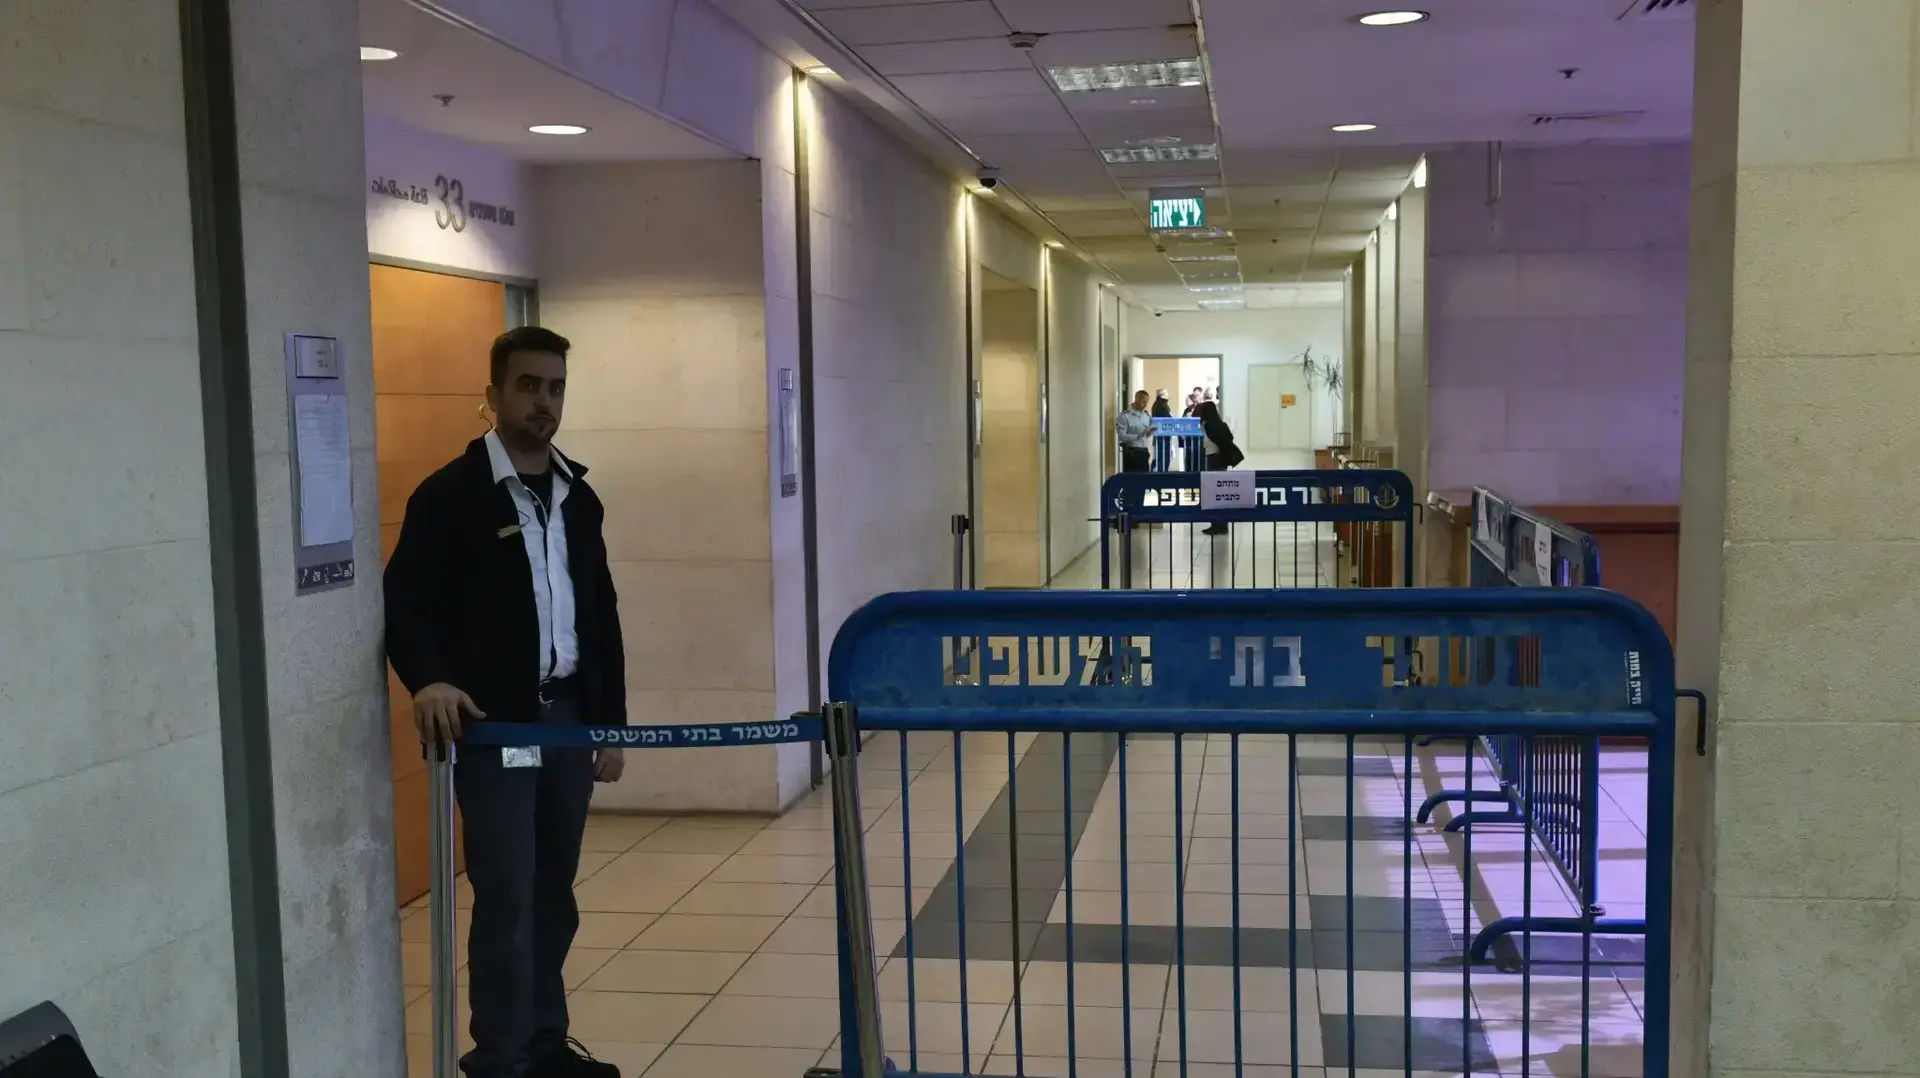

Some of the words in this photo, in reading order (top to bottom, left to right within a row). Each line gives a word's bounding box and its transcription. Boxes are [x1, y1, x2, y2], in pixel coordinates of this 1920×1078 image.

[434, 174, 467, 233] 33
[1152, 199, 1193, 227] יציאה
[1216, 480, 1240, 488] מתחם
[1215, 493, 1241, 501] כתבים
[941, 636, 1153, 687] המשפט
[1209, 636, 1306, 687] בתי
[588, 729, 673, 743] המשפט
[682, 727, 722, 741] בתי
[731, 723, 799, 741] משמר
